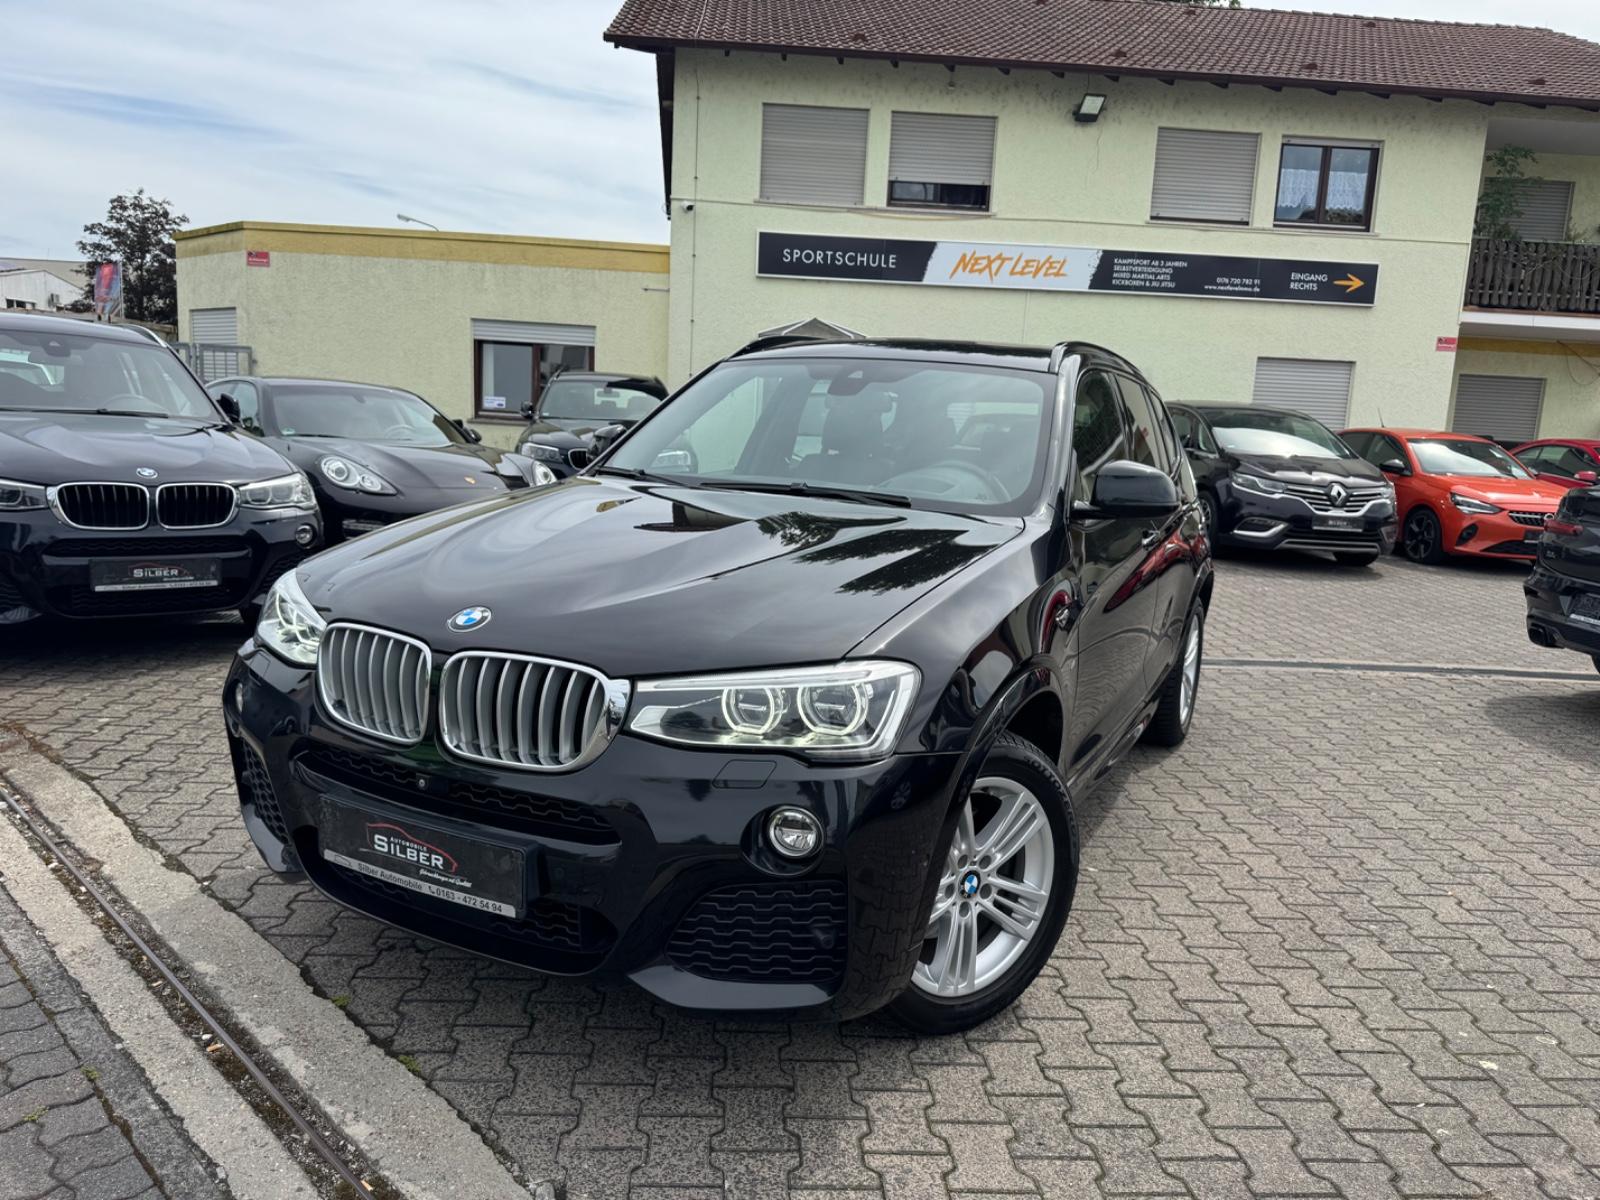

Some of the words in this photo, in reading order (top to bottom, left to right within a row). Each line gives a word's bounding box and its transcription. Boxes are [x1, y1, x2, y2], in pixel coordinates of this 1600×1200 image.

[782, 248, 897, 268] SPORTSCHULE
[1114, 258, 1150, 266] KAMPFSPORT
[949, 250, 1013, 283] NEXT
[1009, 252, 1067, 279] LEVEL
[1113, 265, 1173, 274] SELBSTVERTEIDIGUNG
[1291, 271, 1328, 282] EINGANG
[1112, 279, 1145, 287] KICKBOXEN
[1290, 281, 1318, 291] RECHTS
[133, 568, 179, 577] SILBER
[373, 834, 445, 870] SILBER
[358, 863, 378, 876] Silber
[380, 871, 423, 889] Automobile
[436, 887, 455, 900] 0163
[462, 895, 477, 906] 472
[480, 900, 489, 909] 54
[492, 903, 502, 913] 94
